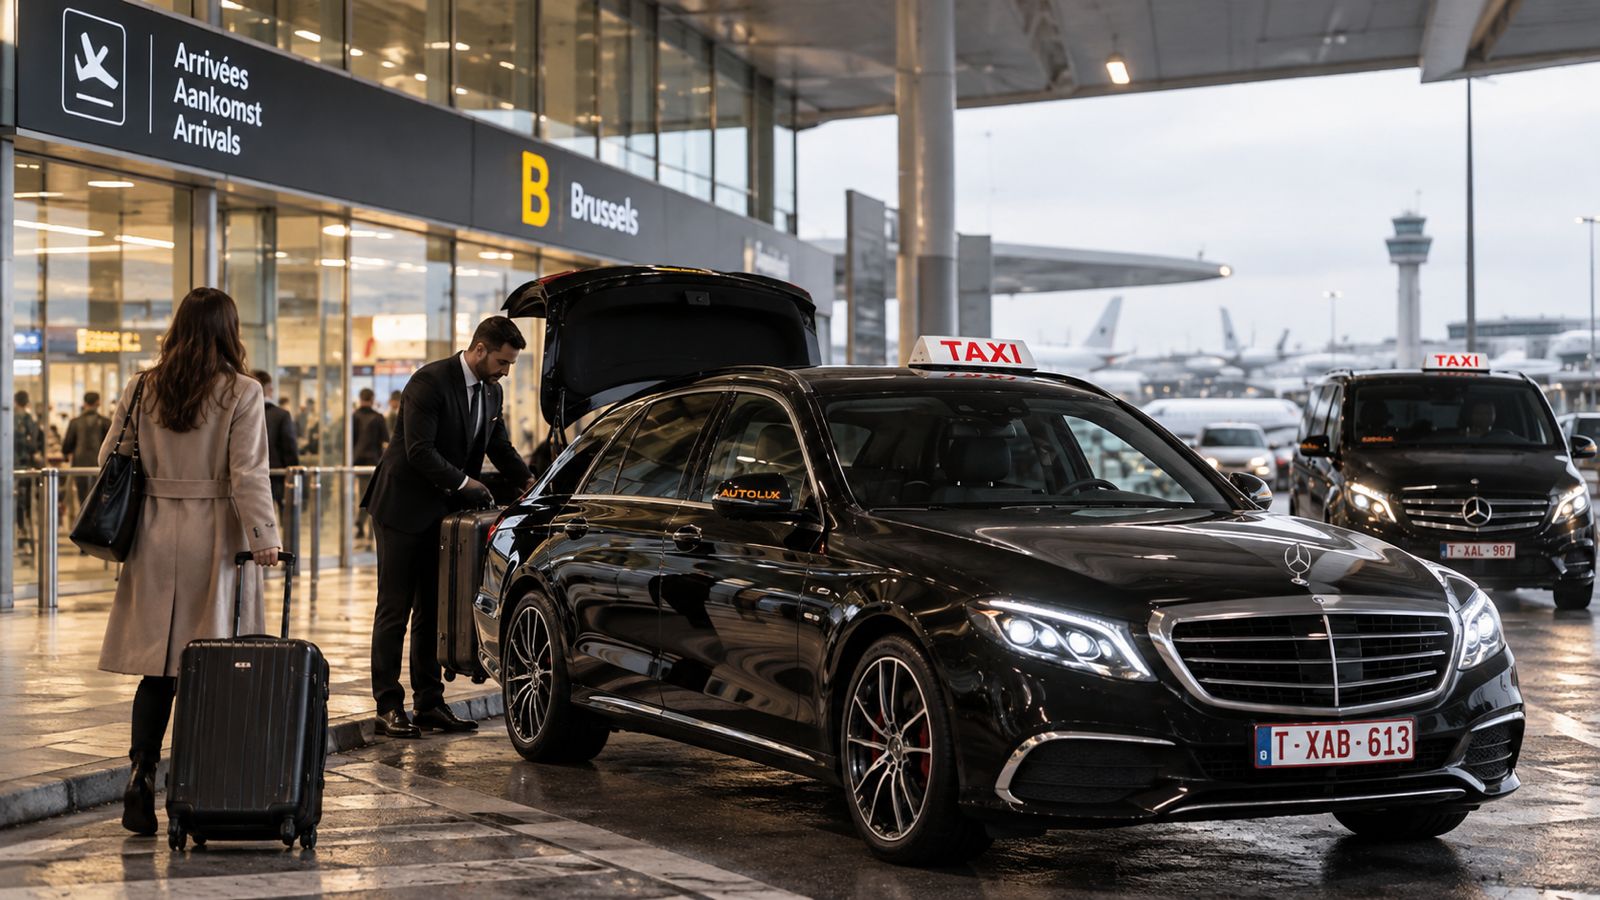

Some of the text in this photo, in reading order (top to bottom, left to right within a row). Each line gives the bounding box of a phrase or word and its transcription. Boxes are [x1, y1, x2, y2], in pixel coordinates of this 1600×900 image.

[174, 42, 249, 90] Arrivées
[173, 77, 262, 127] Aankomst
[173, 113, 241, 156] Arrivals
[522, 150, 639, 236] B Brussels
[940, 340, 1022, 363] TAXI
[1435, 354, 1479, 367] TAXI
[719, 488, 780, 499] AUTOLUX
